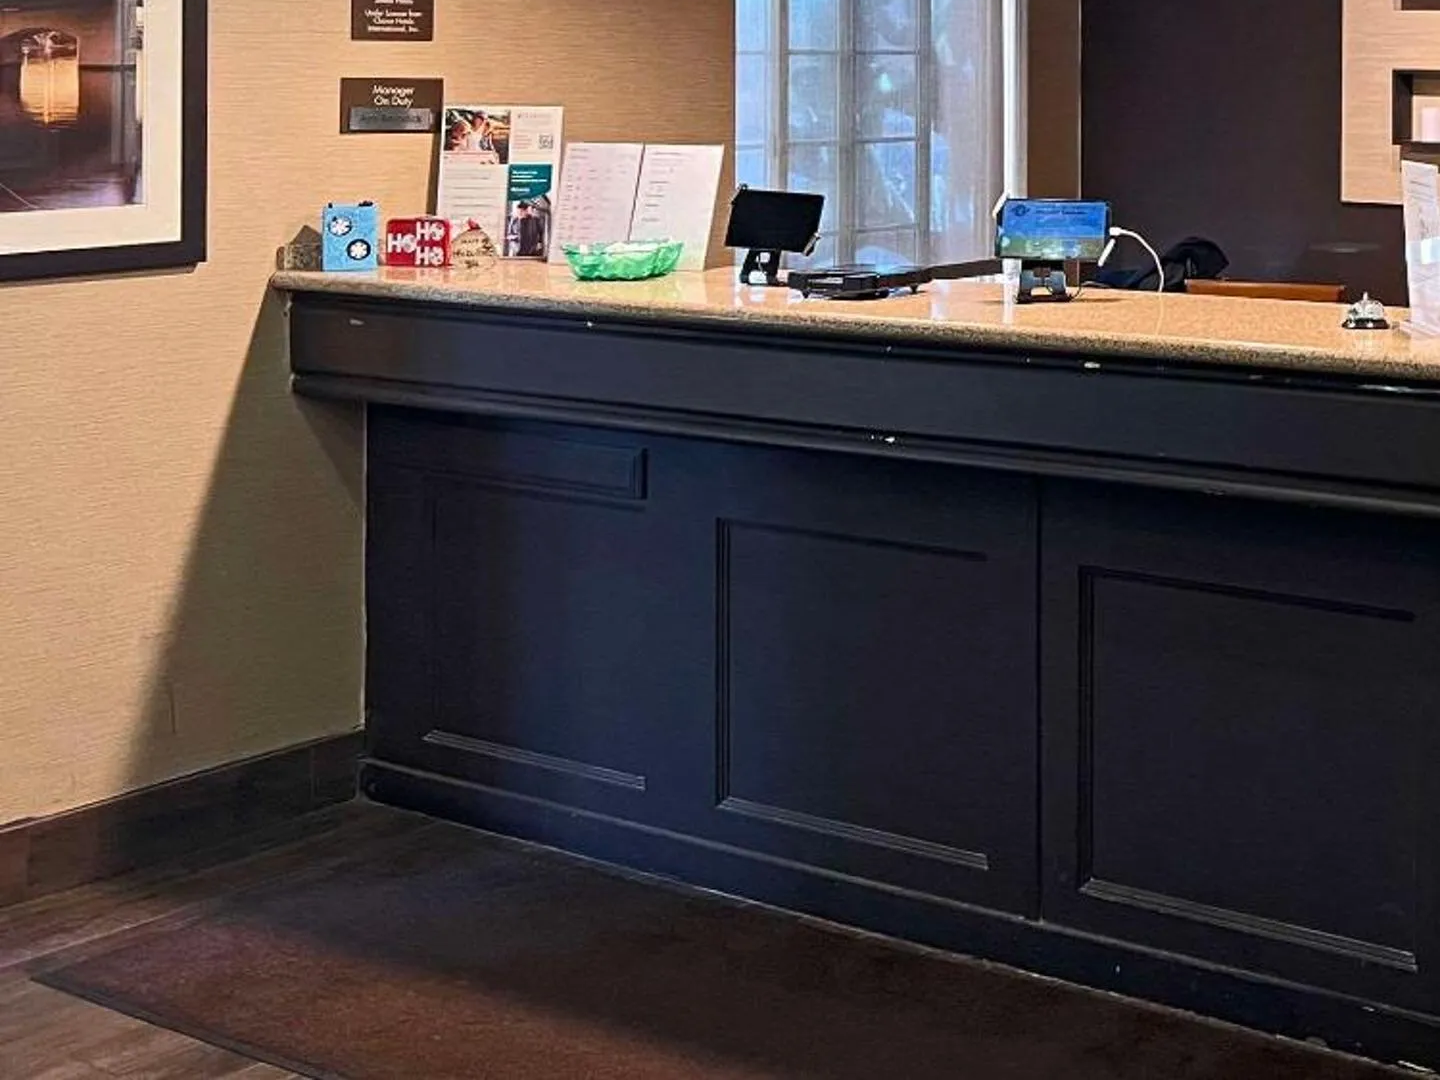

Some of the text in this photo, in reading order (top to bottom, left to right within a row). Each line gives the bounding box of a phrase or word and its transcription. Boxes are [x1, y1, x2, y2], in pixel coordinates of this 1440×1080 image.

[372, 84, 415, 98] Manager
[374, 95, 414, 110] On Duty
[415, 221, 445, 241] HO
[387, 233, 416, 254] HO
